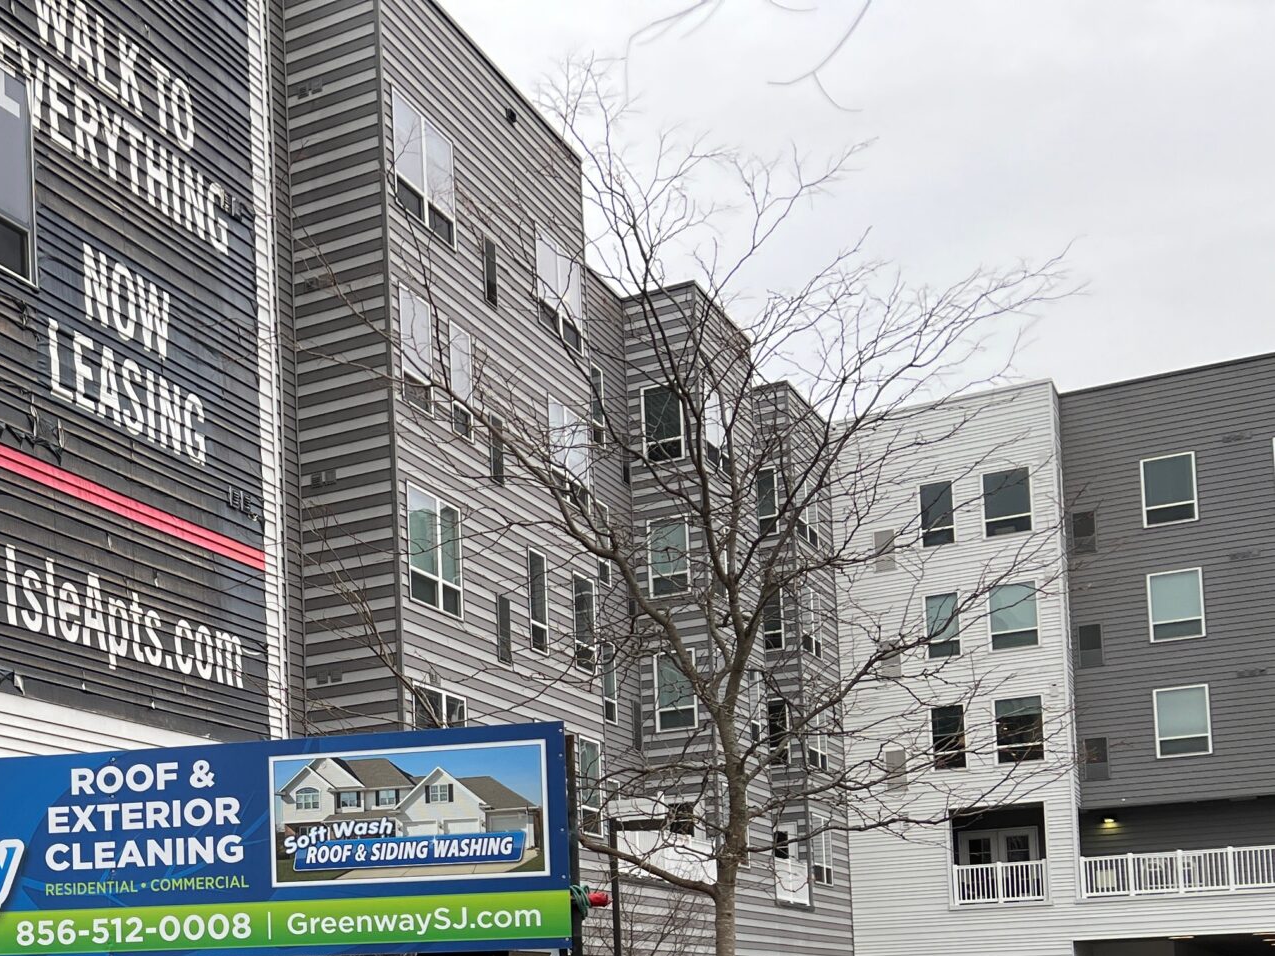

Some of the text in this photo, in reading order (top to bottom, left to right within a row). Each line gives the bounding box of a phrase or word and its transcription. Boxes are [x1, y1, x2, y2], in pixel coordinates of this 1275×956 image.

[34, 0, 195, 151] WALK TO
[83, 242, 171, 361] NOW
[47, 317, 207, 466] LEASING
[4, 544, 244, 688] IsleApts.com
[70, 760, 215, 796] ROOF &
[47, 797, 240, 834] EXTERIOR
[283, 816, 393, 854] Soft Wash
[305, 836, 513, 864] ROOF & SIDING WASHING
[44, 837, 244, 872] CLEANING
[44, 876, 250, 896] RESIDENTIAL COMMERCIAL
[15, 907, 542, 946] 856-512-0008 GreenwaySJ.com
